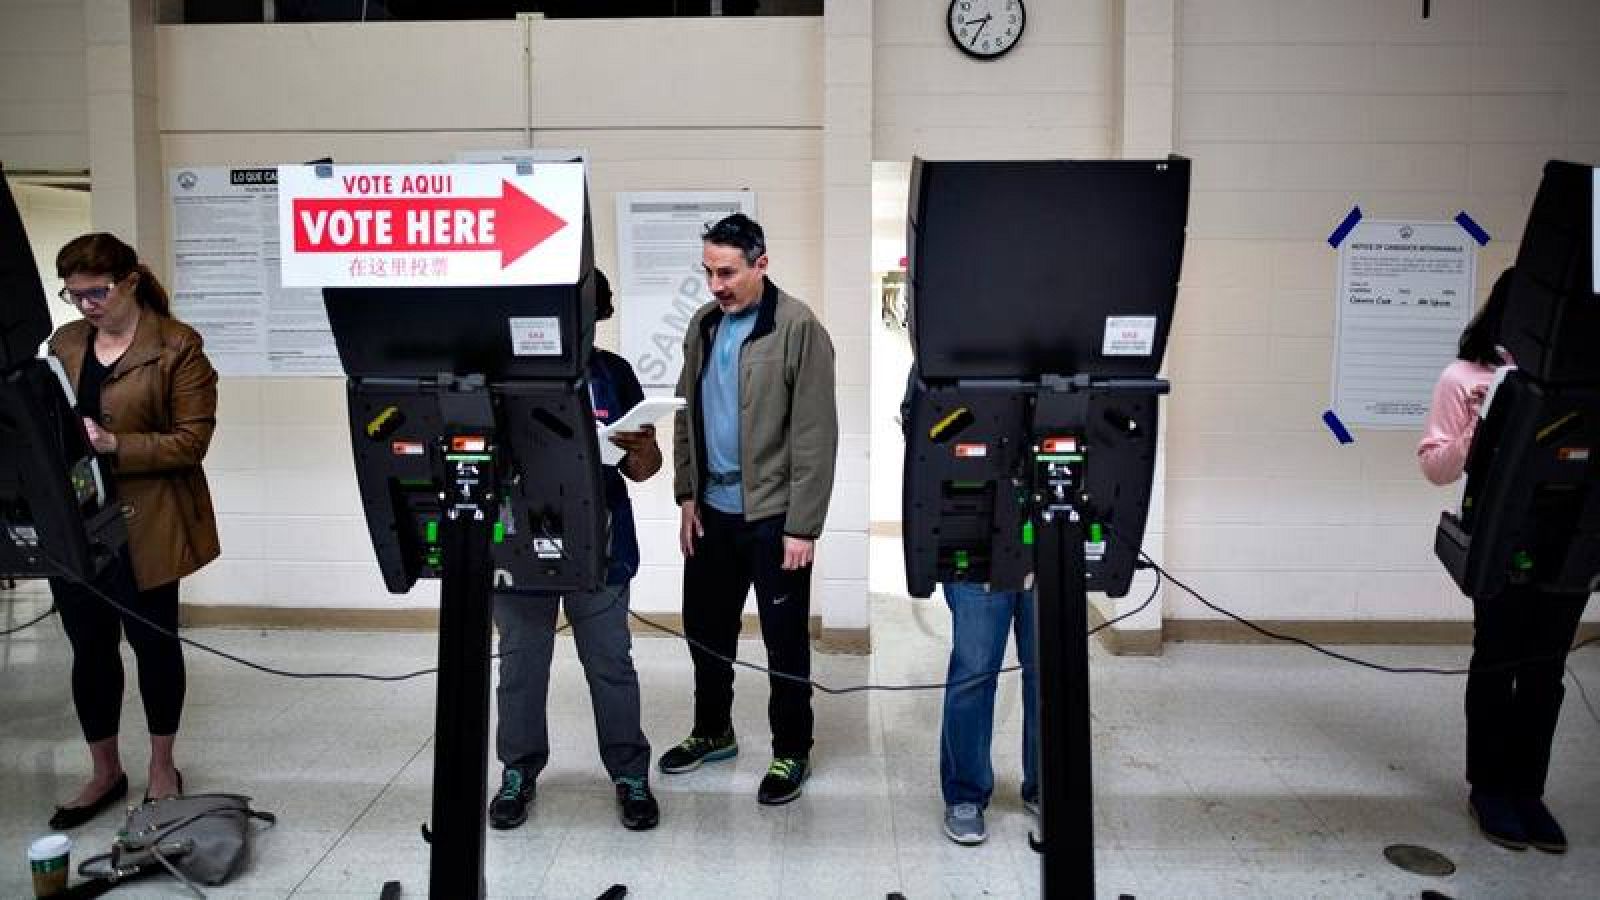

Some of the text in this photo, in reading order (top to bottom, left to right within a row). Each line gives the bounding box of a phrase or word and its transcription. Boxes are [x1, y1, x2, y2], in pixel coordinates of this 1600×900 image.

[342, 174, 453, 194] VOTE AQUI
[300, 209, 393, 245] VOTE
[406, 209, 496, 245] HERE
